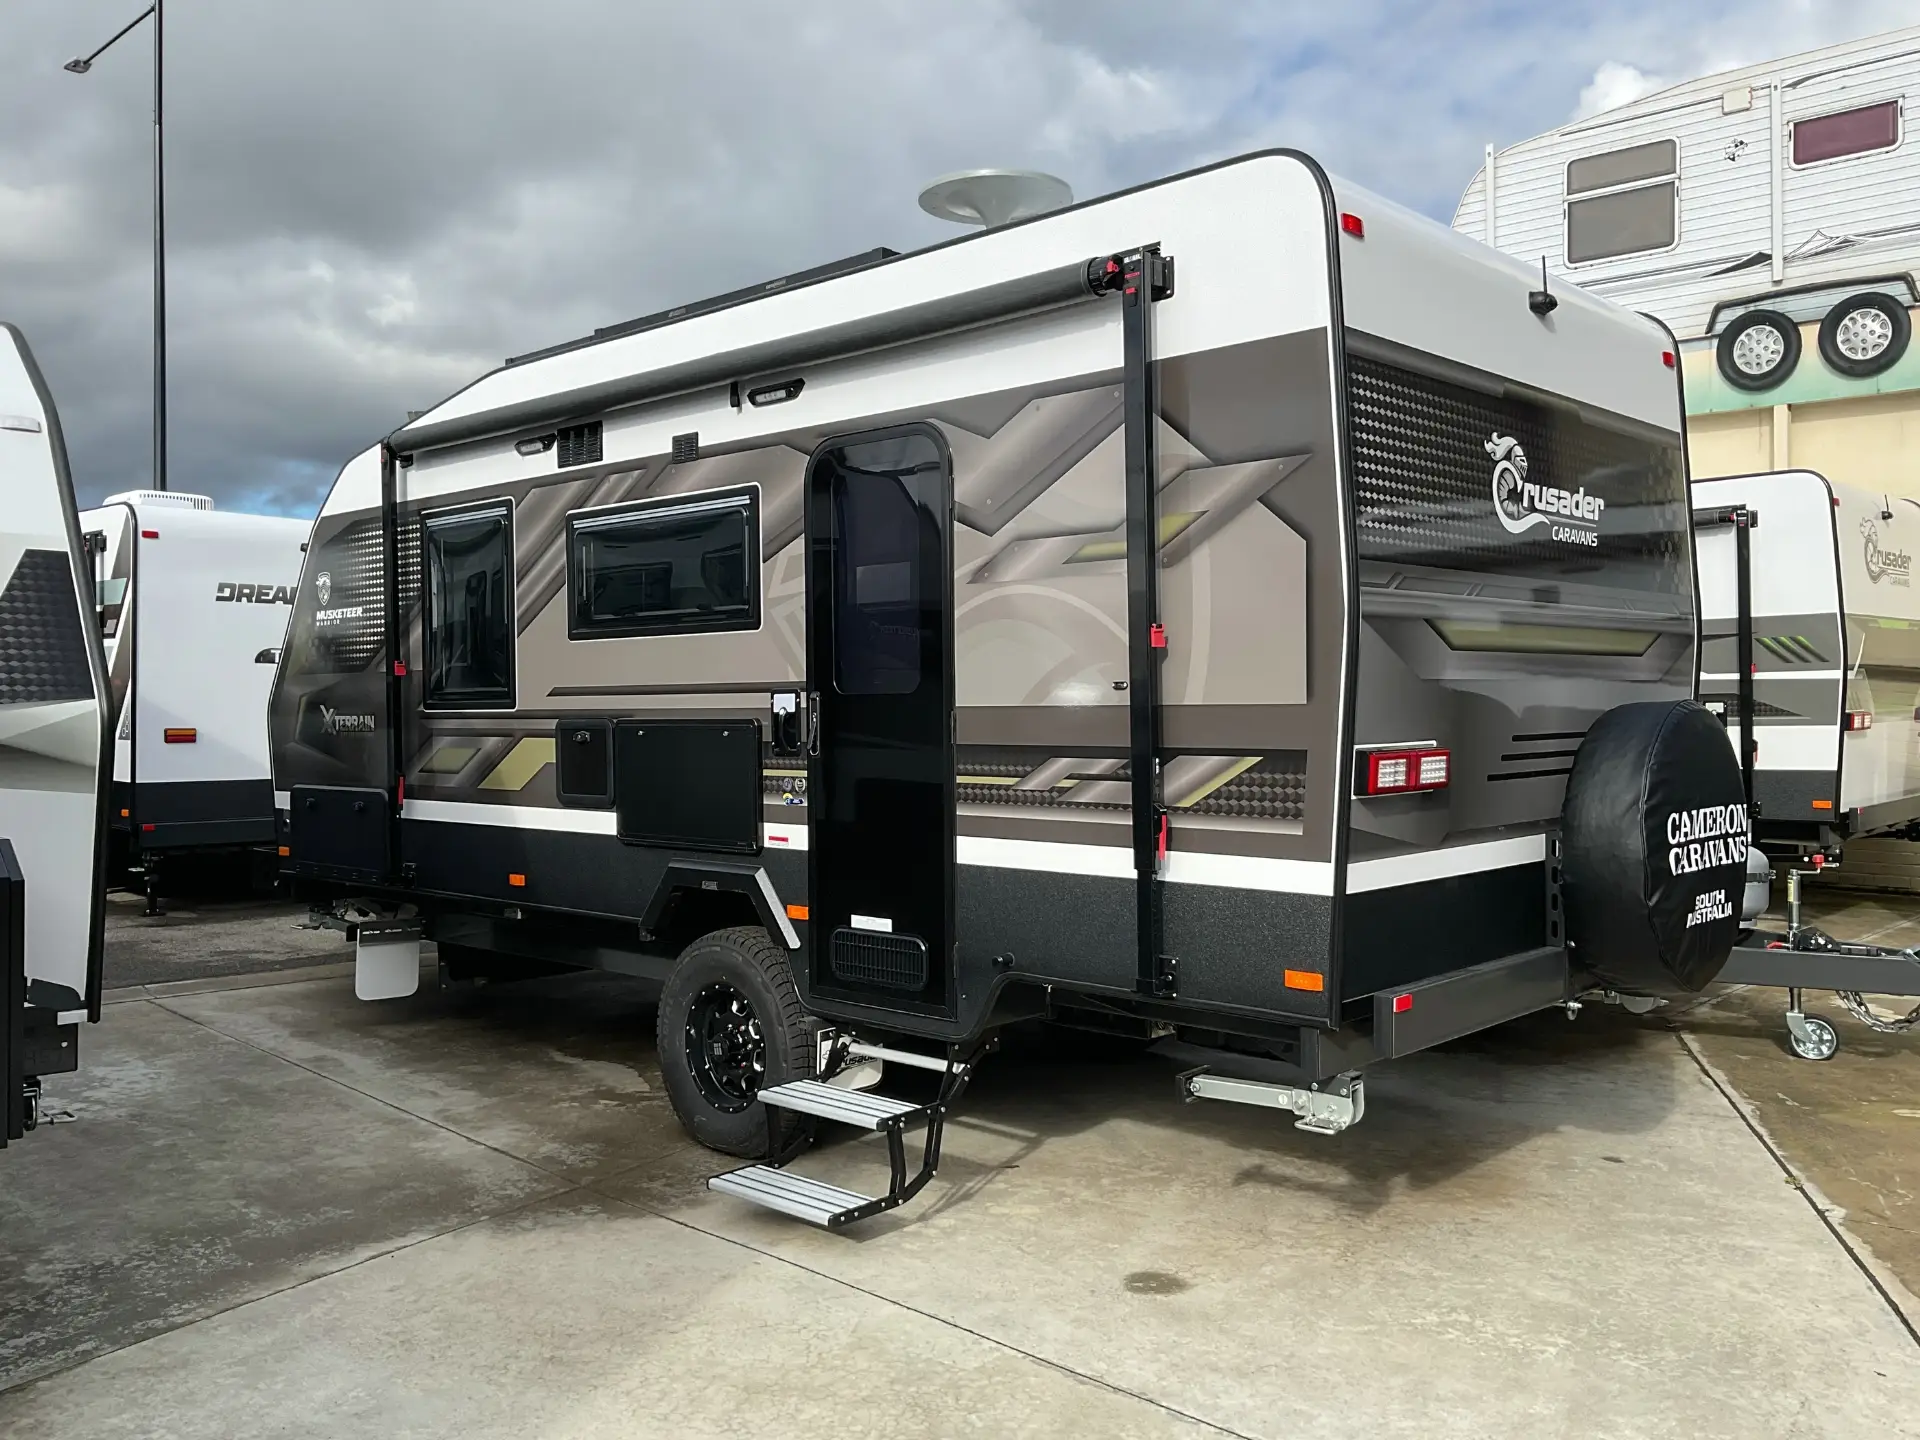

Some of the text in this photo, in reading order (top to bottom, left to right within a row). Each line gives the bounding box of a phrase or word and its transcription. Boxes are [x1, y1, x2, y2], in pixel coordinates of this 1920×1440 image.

[1492, 460, 1605, 534] Crusader
[1552, 526, 1598, 547] CARAVANS
[316, 606, 363, 621] MUSKETEER
[1667, 803, 1748, 845] CAMERON
[1668, 835, 1748, 876] CARAVANS
[1695, 889, 1725, 910] SOUTH
[1686, 901, 1733, 929] AUSTRALIA
